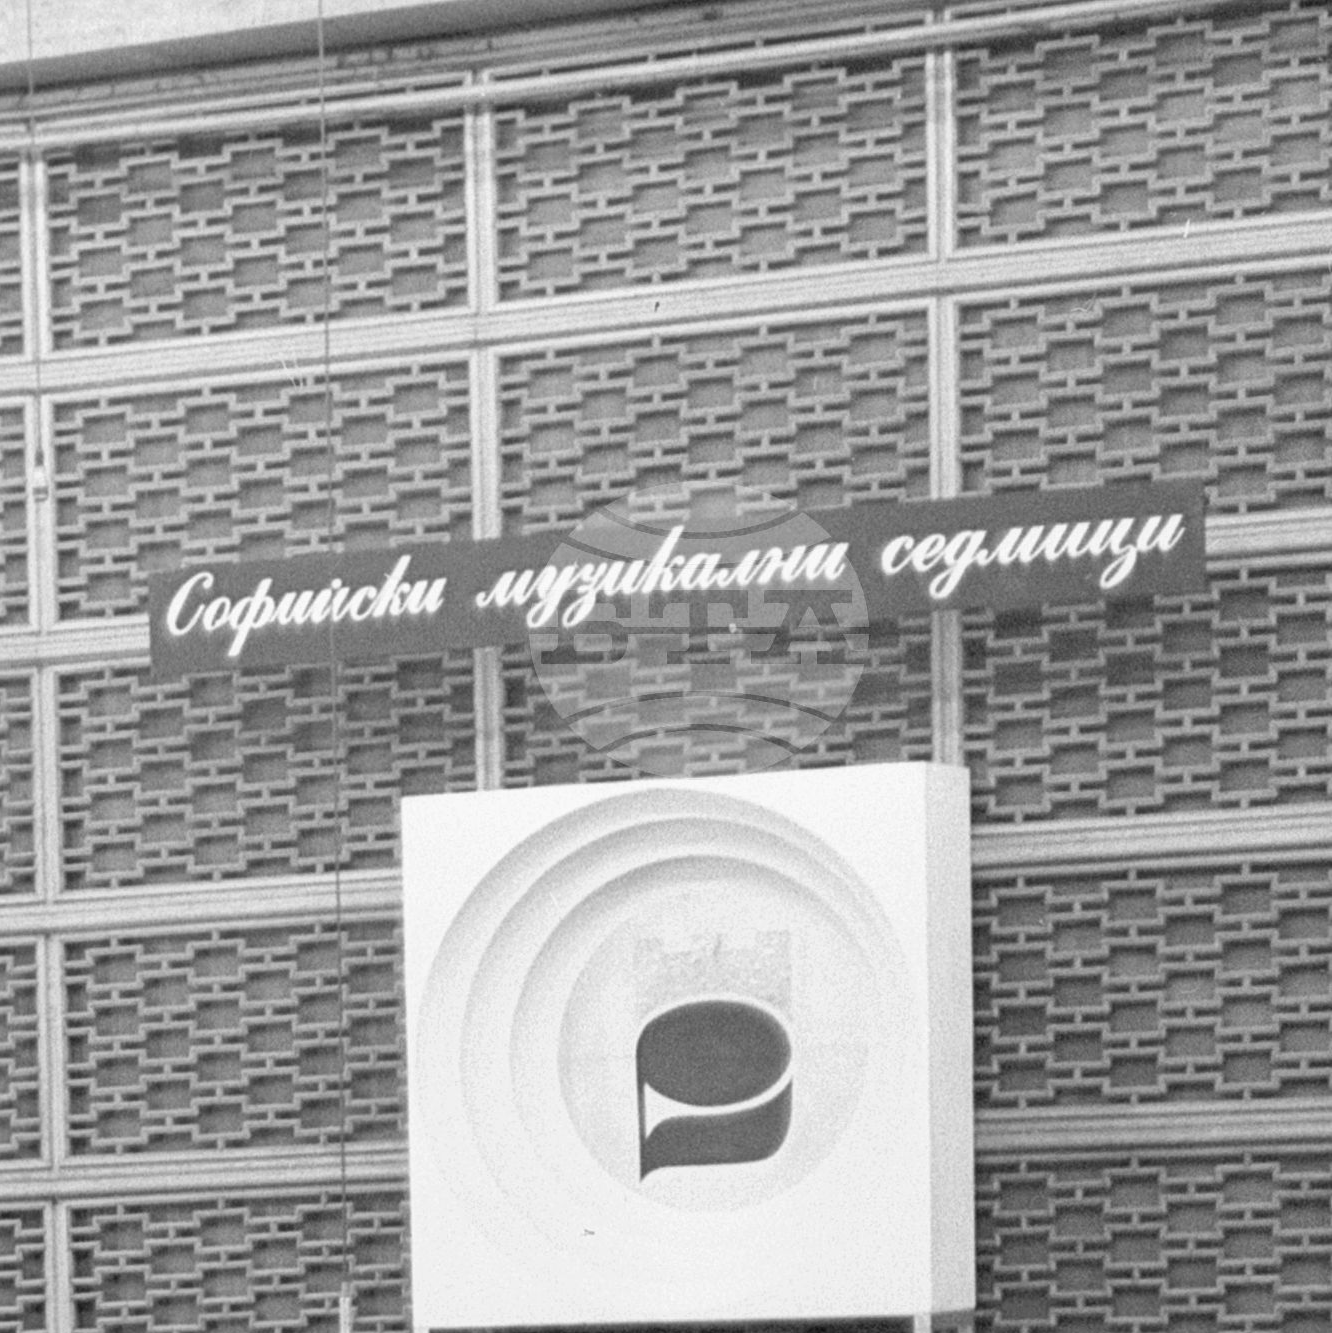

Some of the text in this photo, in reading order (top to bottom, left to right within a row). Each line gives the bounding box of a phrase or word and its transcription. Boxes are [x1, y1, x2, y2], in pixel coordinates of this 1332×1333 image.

[166, 513, 1185, 656] Софийски музикални седмици
